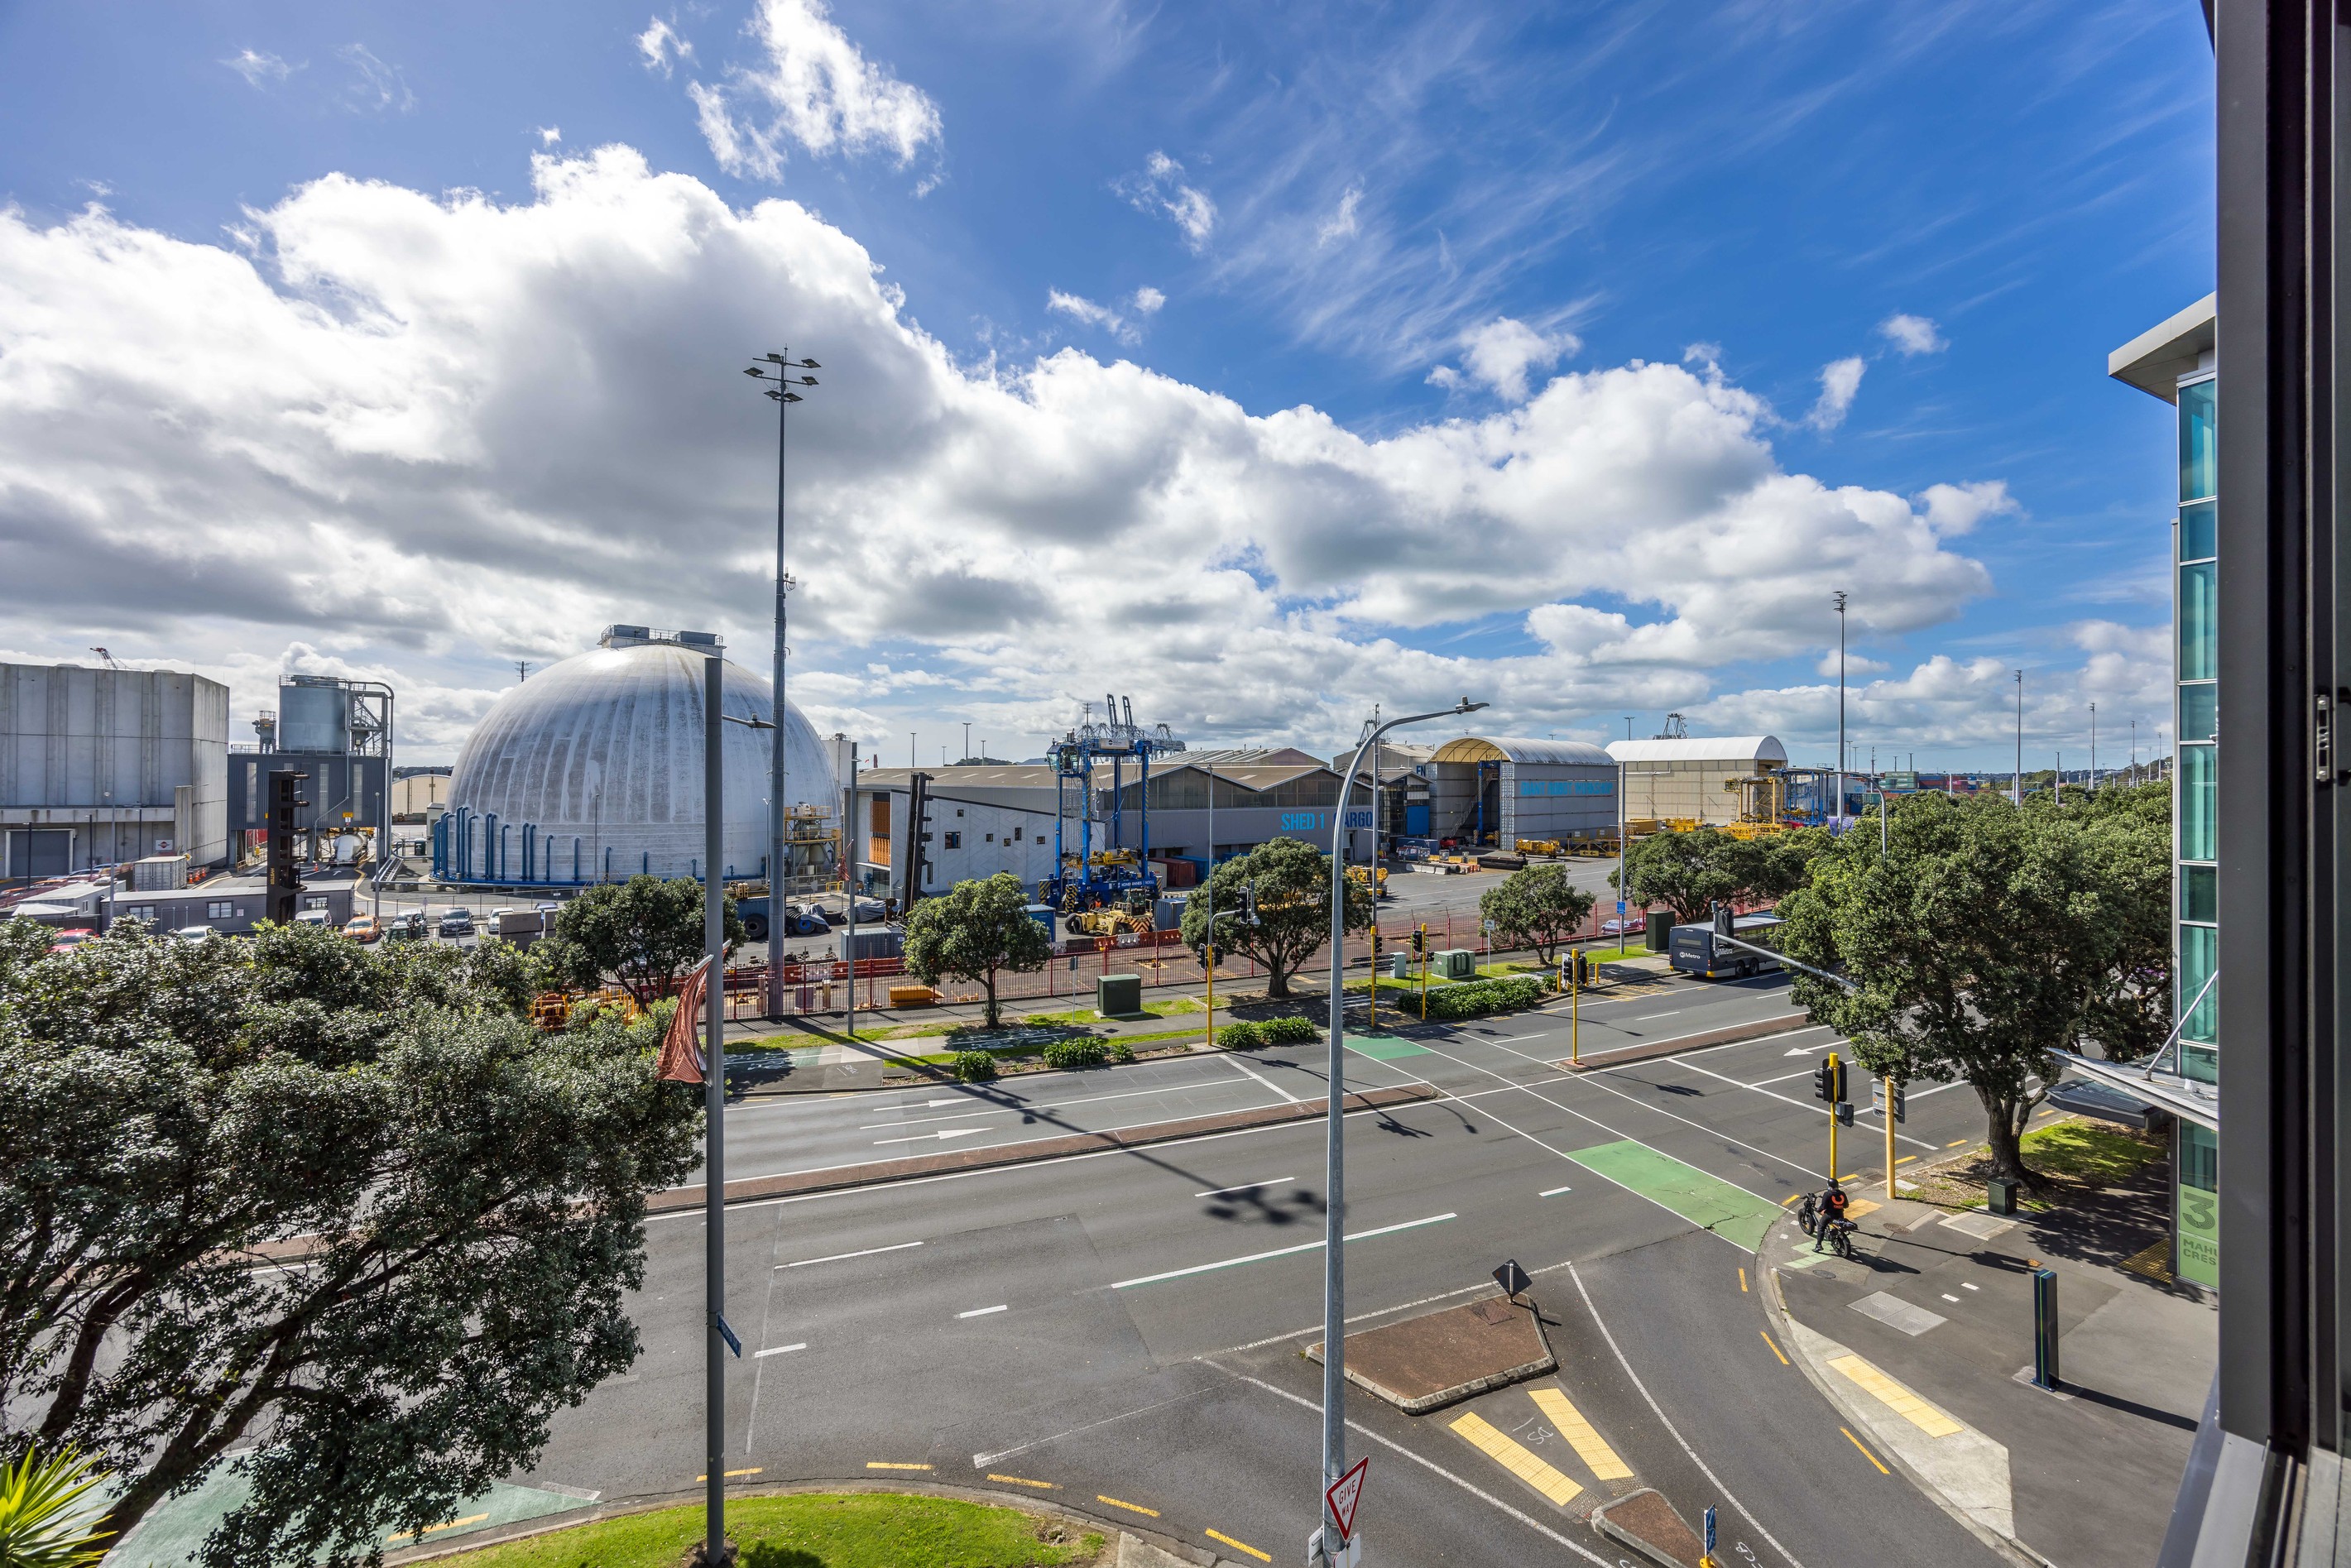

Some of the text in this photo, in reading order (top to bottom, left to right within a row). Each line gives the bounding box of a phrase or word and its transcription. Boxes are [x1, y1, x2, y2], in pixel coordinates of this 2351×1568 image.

[1281, 813, 1325, 832] SHED 1
[2182, 1192, 2215, 1230] 3
[2183, 1248, 2217, 1266] CRES
[1338, 1479, 1356, 1504] GIVE
[1341, 1499, 1353, 1518] WAY
